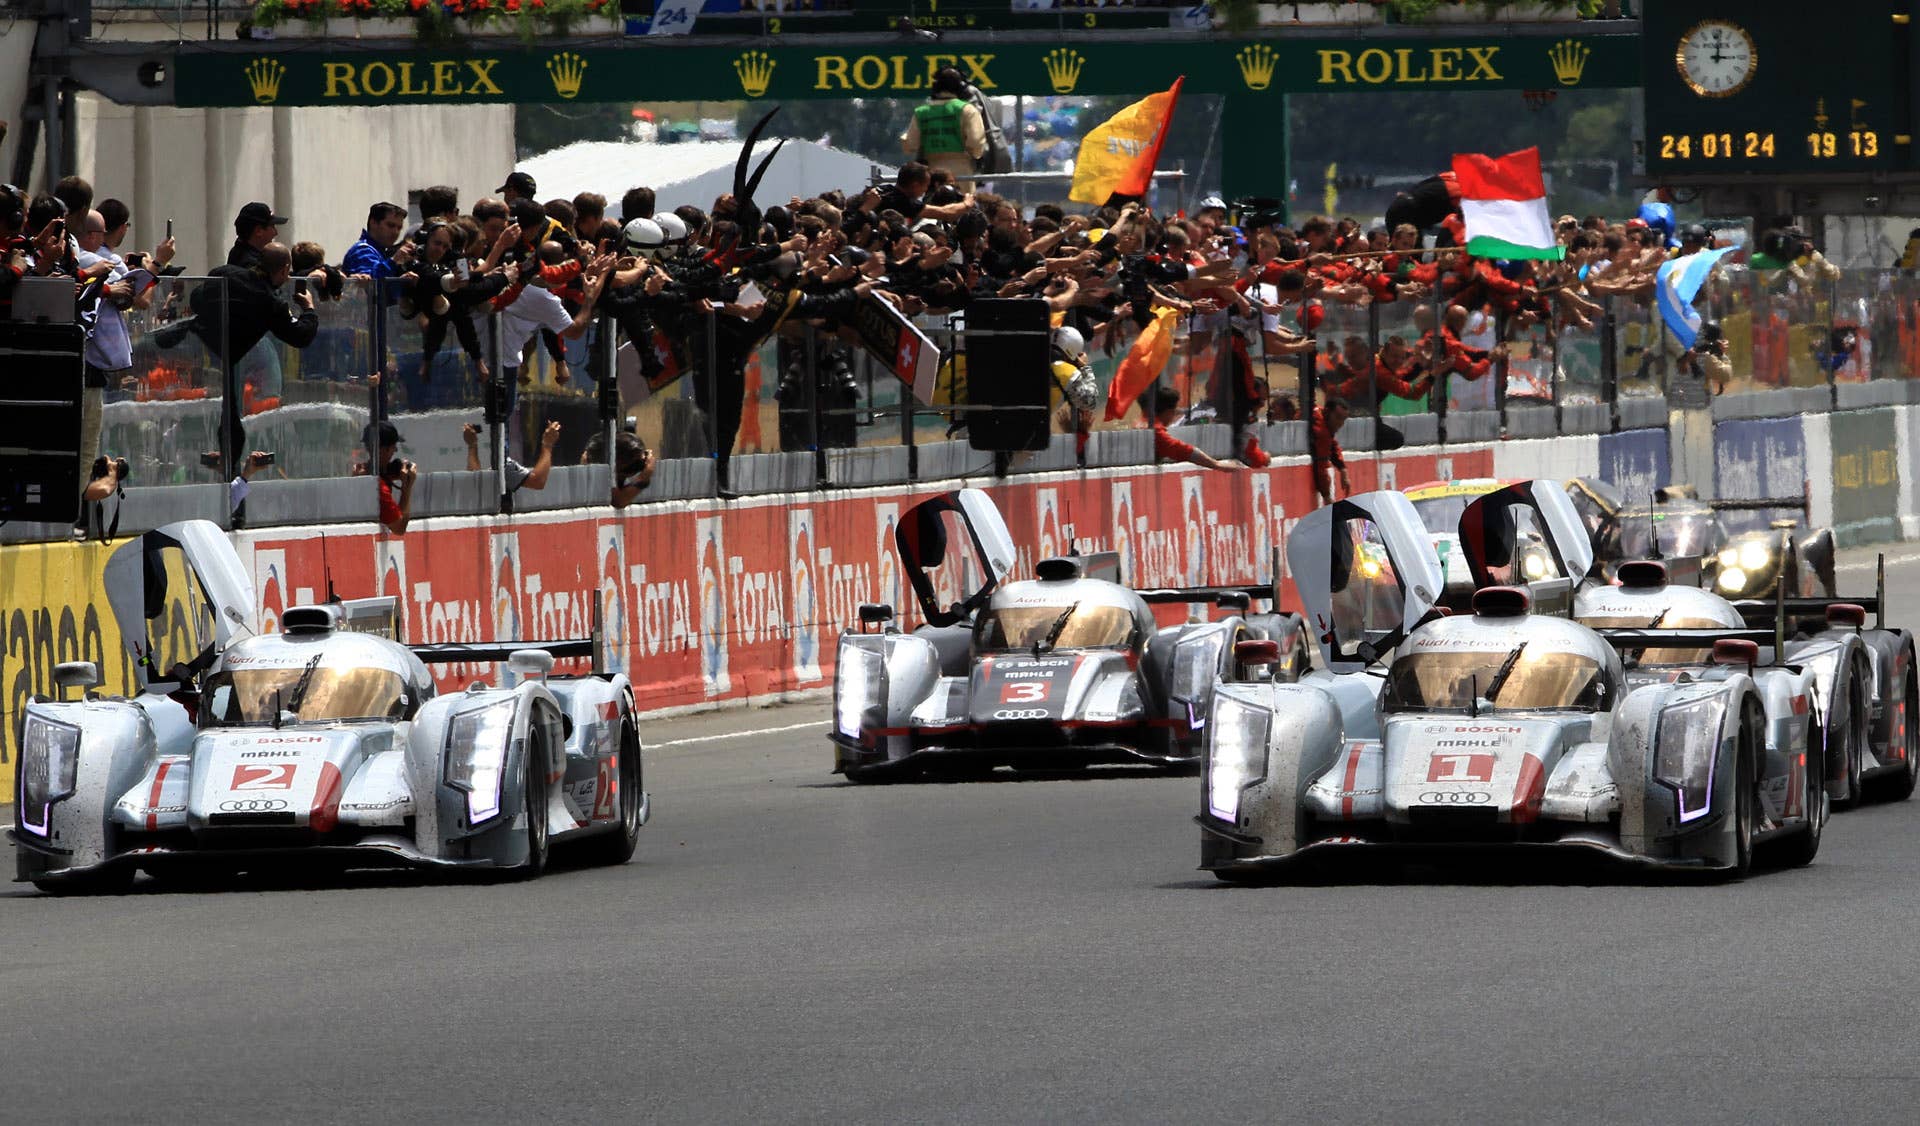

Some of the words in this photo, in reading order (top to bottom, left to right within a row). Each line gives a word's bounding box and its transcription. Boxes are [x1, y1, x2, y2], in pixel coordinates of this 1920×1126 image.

[658, 7, 688, 26] 24
[1084, 13, 1097, 28] 3
[768, 17, 781, 34] 2
[1316, 46, 1505, 85] ROLEX
[322, 58, 504, 98] ROLEX
[1807, 131, 1838, 159] 19
[1848, 130, 1879, 157] 13
[629, 563, 698, 658] TOTAL
[728, 555, 792, 647] TOTAL
[1207, 510, 1254, 587] TOTAL
[1416, 637, 1449, 648] Audi
[226, 655, 257, 665] Audi
[1017, 659, 1069, 667] BOSCH
[1004, 670, 1055, 679] MAHLE
[1006, 682, 1046, 704] 3
[1454, 726, 1522, 734] BOSCH
[256, 736, 323, 744] BOSCH
[240, 750, 302, 758] MAHLE
[1436, 756, 1482, 781] 1
[236, 765, 287, 790] 2
